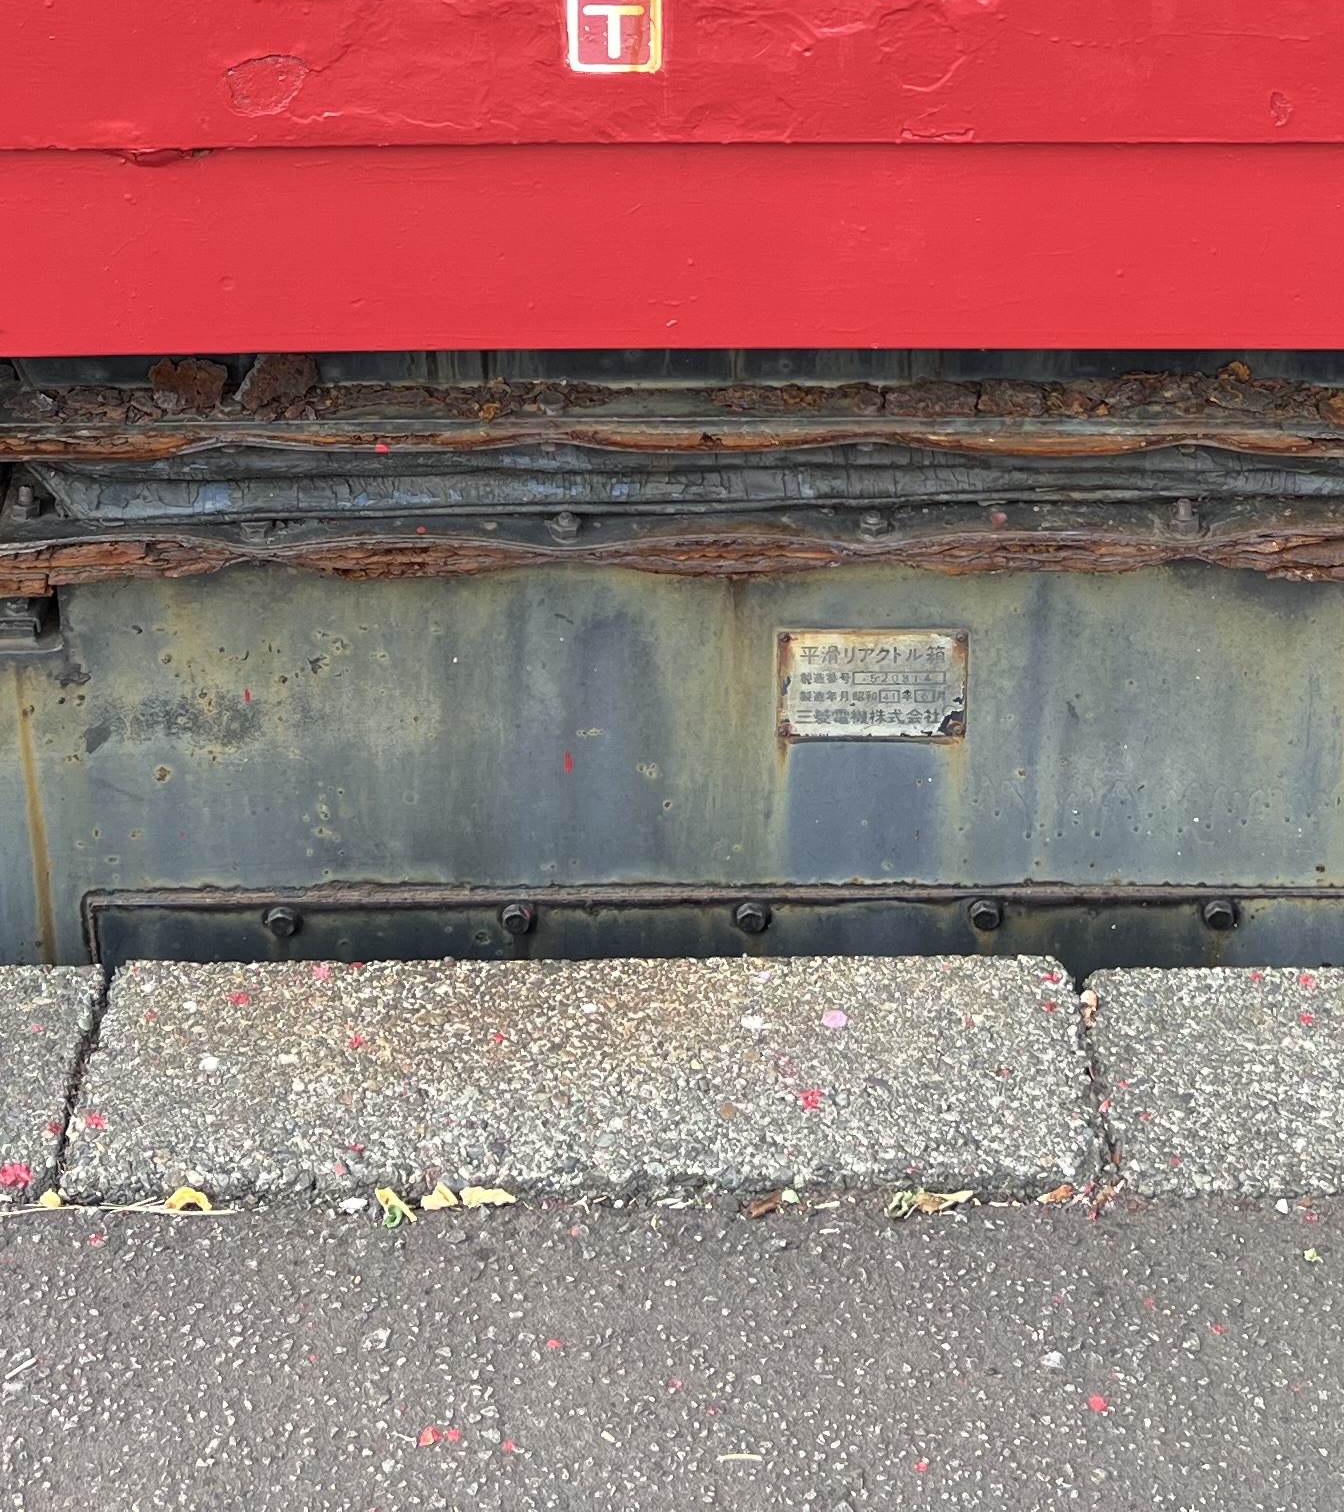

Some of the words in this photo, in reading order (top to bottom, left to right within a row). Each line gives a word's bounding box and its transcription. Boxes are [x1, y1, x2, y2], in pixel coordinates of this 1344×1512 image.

[582, 4, 645, 59] T
[799, 645, 946, 665] 平滑リアクトル箱
[794, 707, 942, 725] 三菱電機株式会社
